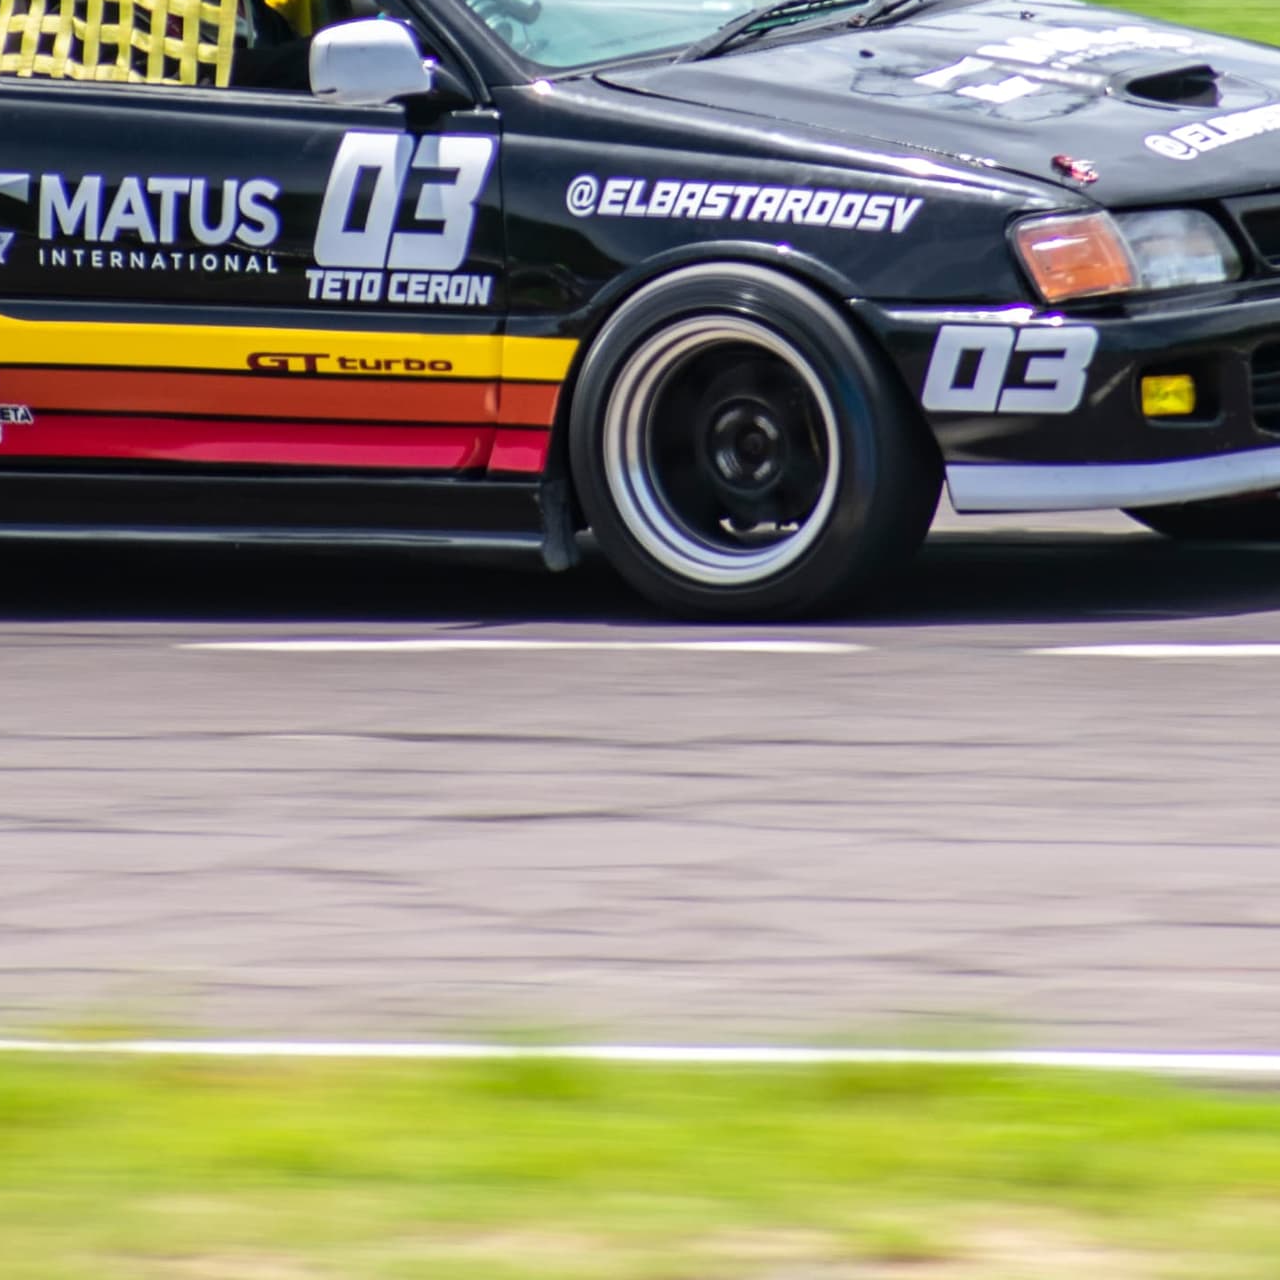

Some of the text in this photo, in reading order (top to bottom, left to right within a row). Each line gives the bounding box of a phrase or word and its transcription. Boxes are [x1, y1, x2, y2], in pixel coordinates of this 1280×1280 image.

[38, 173, 280, 247] MATUS
[312, 131, 494, 272] 03
[37, 248, 279, 274] INTERNATIONAL
[304, 269, 493, 307] TETO CERON
[246, 351, 454, 373] GT turbo
[921, 323, 1099, 414] 03
